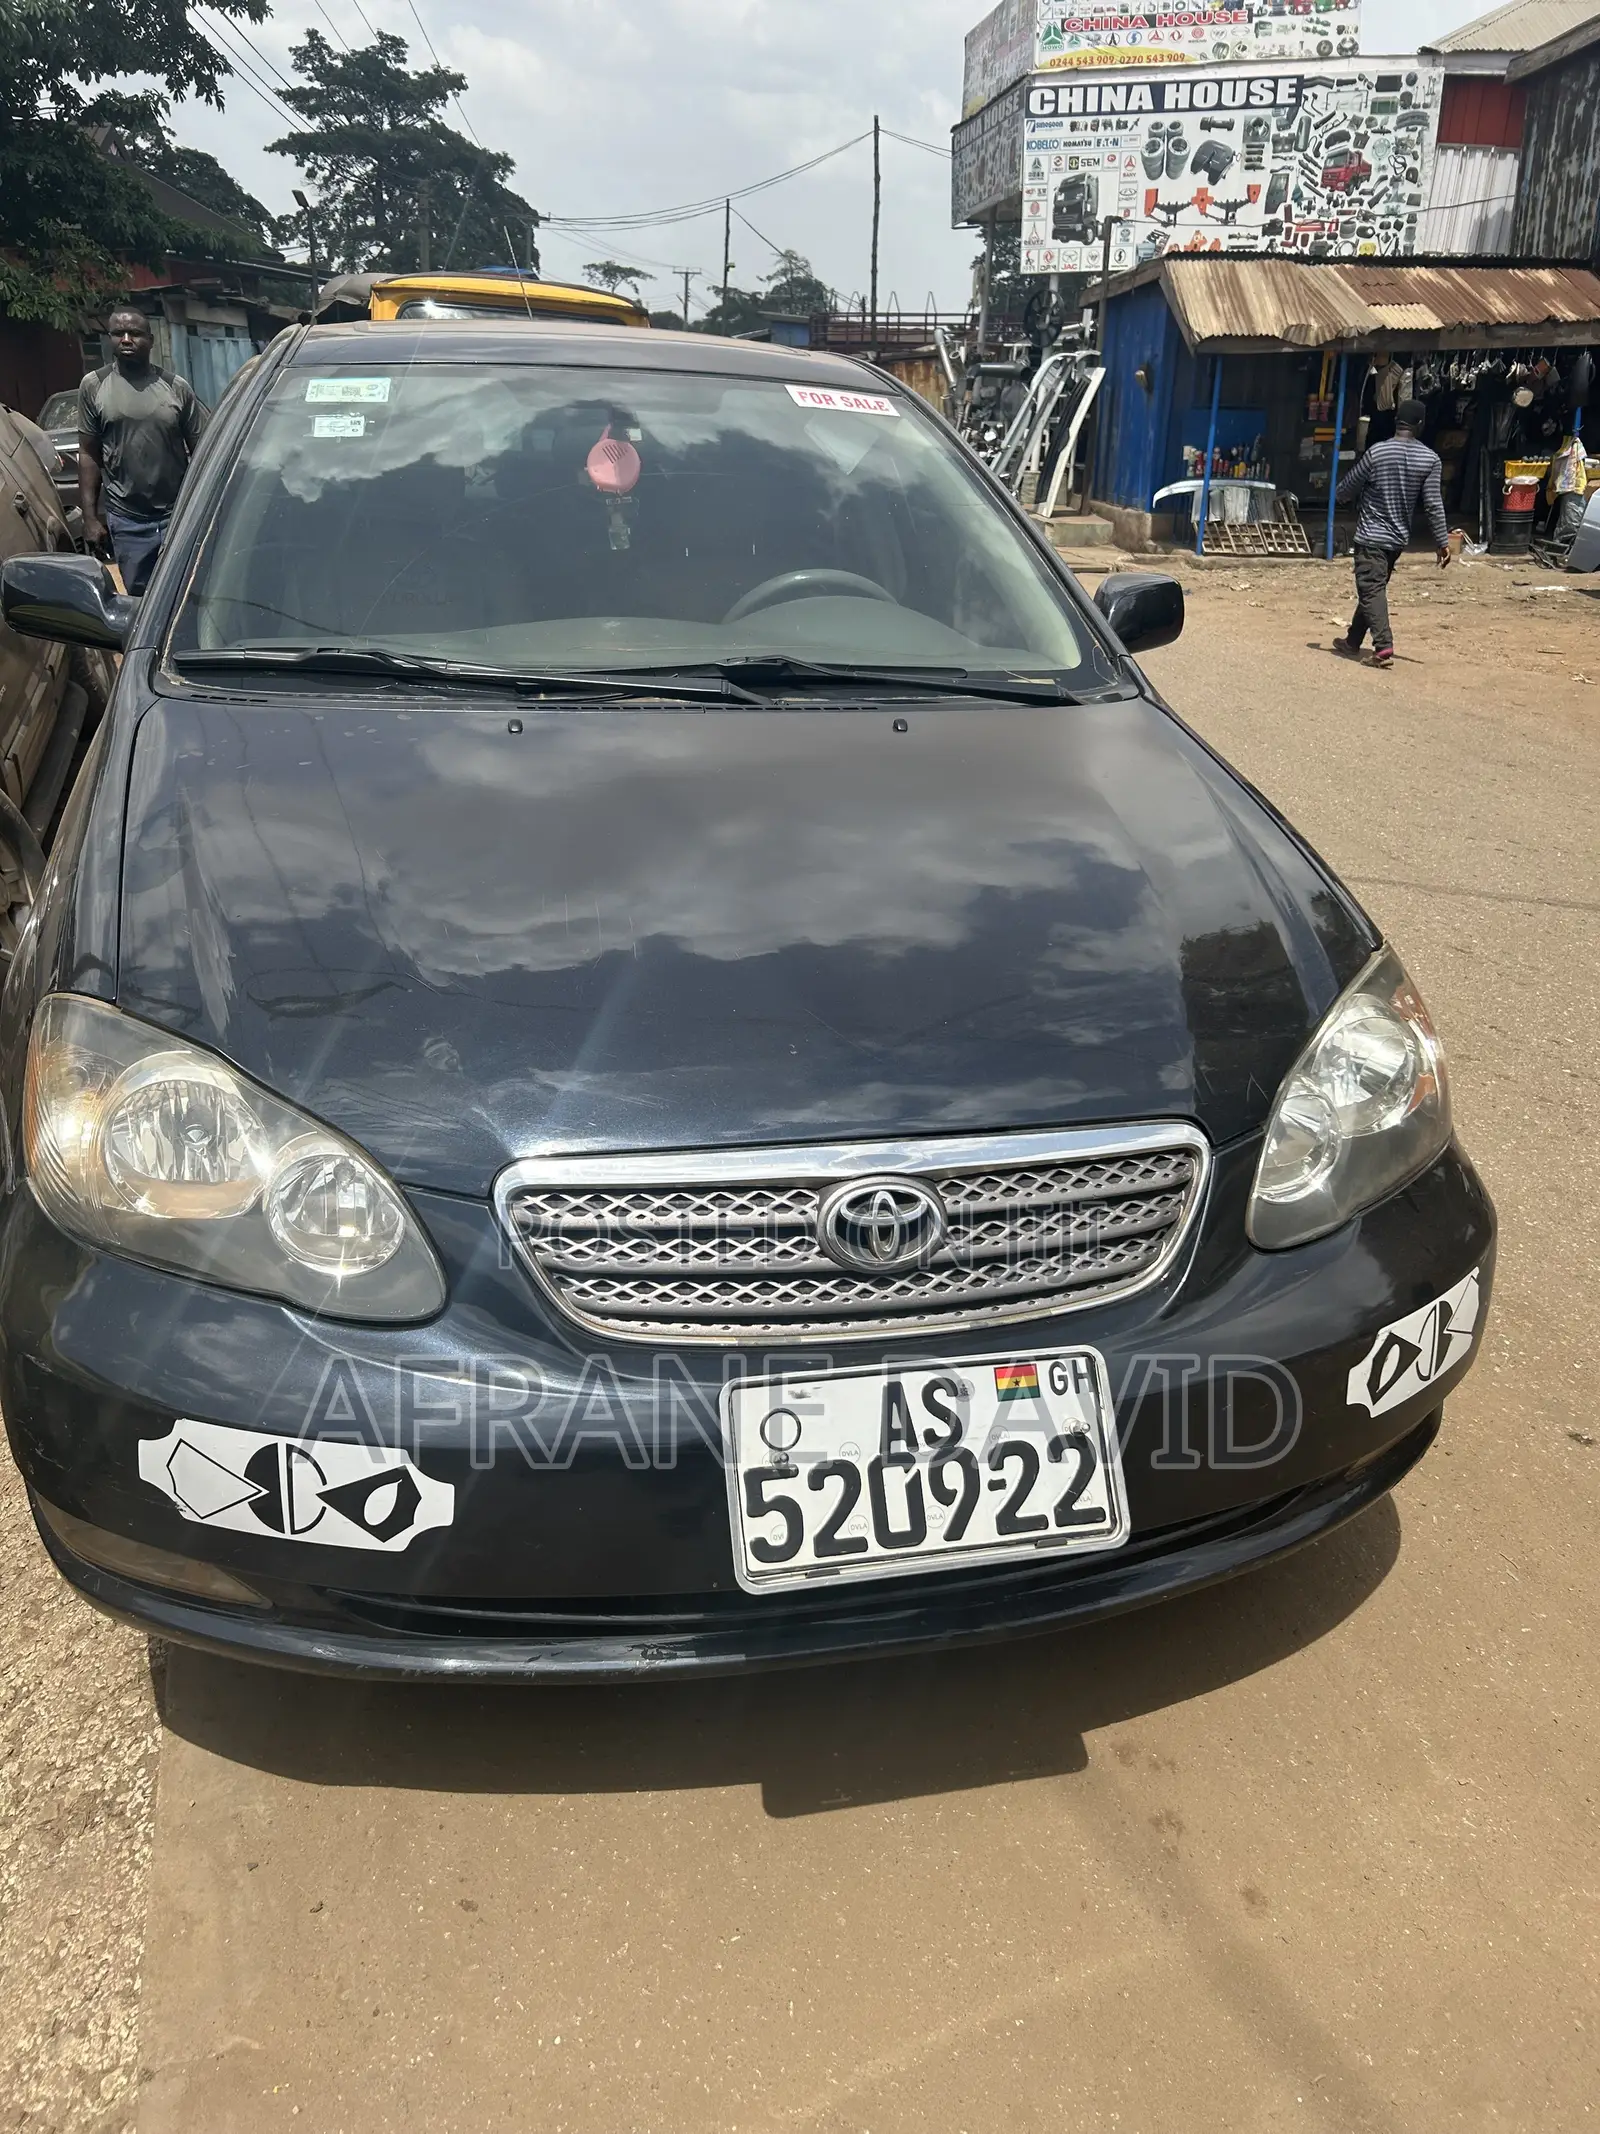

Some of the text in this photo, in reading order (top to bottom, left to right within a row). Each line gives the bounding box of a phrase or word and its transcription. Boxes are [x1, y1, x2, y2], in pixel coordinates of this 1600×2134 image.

[1065, 10, 1249, 32] CHINA HOUSE
[1050, 57, 1073, 67] 0244
[1076, 56, 1094, 66] 543
[1119, 54, 1144, 64] 0270
[1146, 54, 1165, 63] 543
[1167, 52, 1185, 62] 909
[1028, 78, 1297, 115] CHINA HOUSE
[954, 90, 1020, 151] CHINA HOUSE
[1026, 139, 1059, 150] KOBELCO
[1063, 139, 1092, 147] KOMATSU
[1080, 158, 1100, 167] SEM
[797, 391, 889, 411] FOR SALE
[1048, 1358, 1096, 1396] GH
[879, 1377, 963, 1453] AS
[841, 1450, 859, 1458] DVLA
[744, 1434, 1106, 1563] 5209-22
[850, 1522, 868, 1531] DVLA
